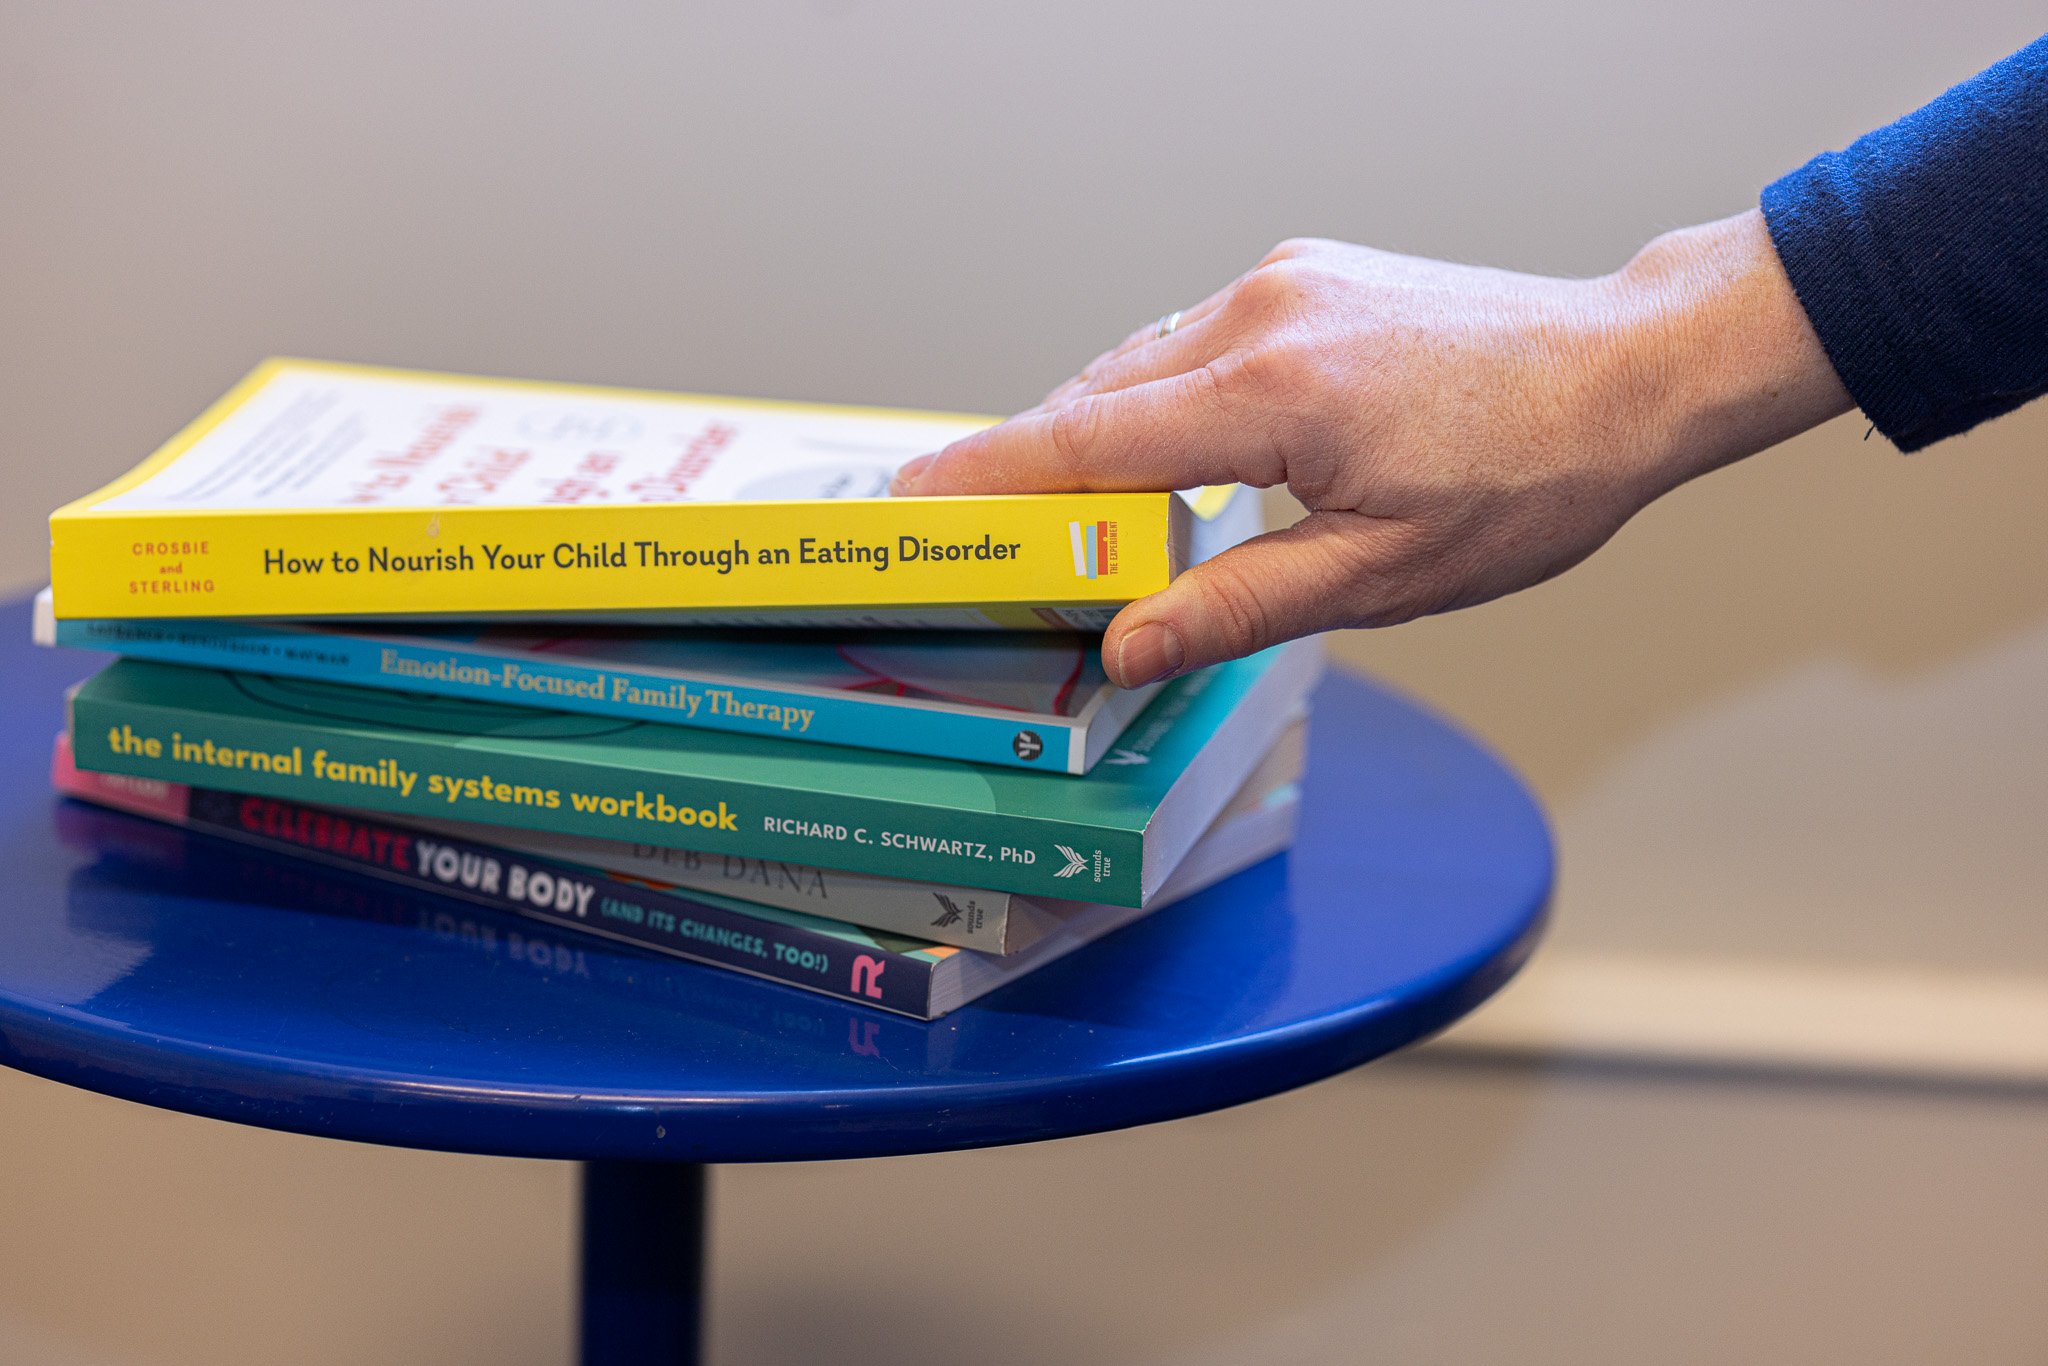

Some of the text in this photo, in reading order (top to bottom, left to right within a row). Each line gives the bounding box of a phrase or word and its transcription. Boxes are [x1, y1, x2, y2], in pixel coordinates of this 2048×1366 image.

[131, 541, 210, 556] CROSBIE
[264, 534, 1021, 575] How to Nourish Your Child Through an Eating Disorder
[1108, 520, 1119, 575] THE EXPERIMENT
[128, 580, 216, 595] STERLING
[159, 561, 184, 576] and
[379, 648, 816, 733] Emotion-Focused Family Therapy
[107, 724, 739, 832] the internal family systems workbook
[763, 815, 1037, 866] RICHARD C. SCHWARTZ, PhD
[238, 798, 412, 871] CELEBRATE
[414, 840, 501, 895] YOUR
[506, 863, 596, 919] BODY
[599, 896, 646, 925] (AND
[646, 905, 675, 933] ITS
[773, 940, 830, 975] TOO!)
[722, 854, 829, 900] DANA
[1093, 849, 1103, 883] sounds
[1102, 856, 1112, 877] true
[966, 900, 977, 935] sounds
[975, 905, 985, 930] true
[850, 953, 886, 1000] R
